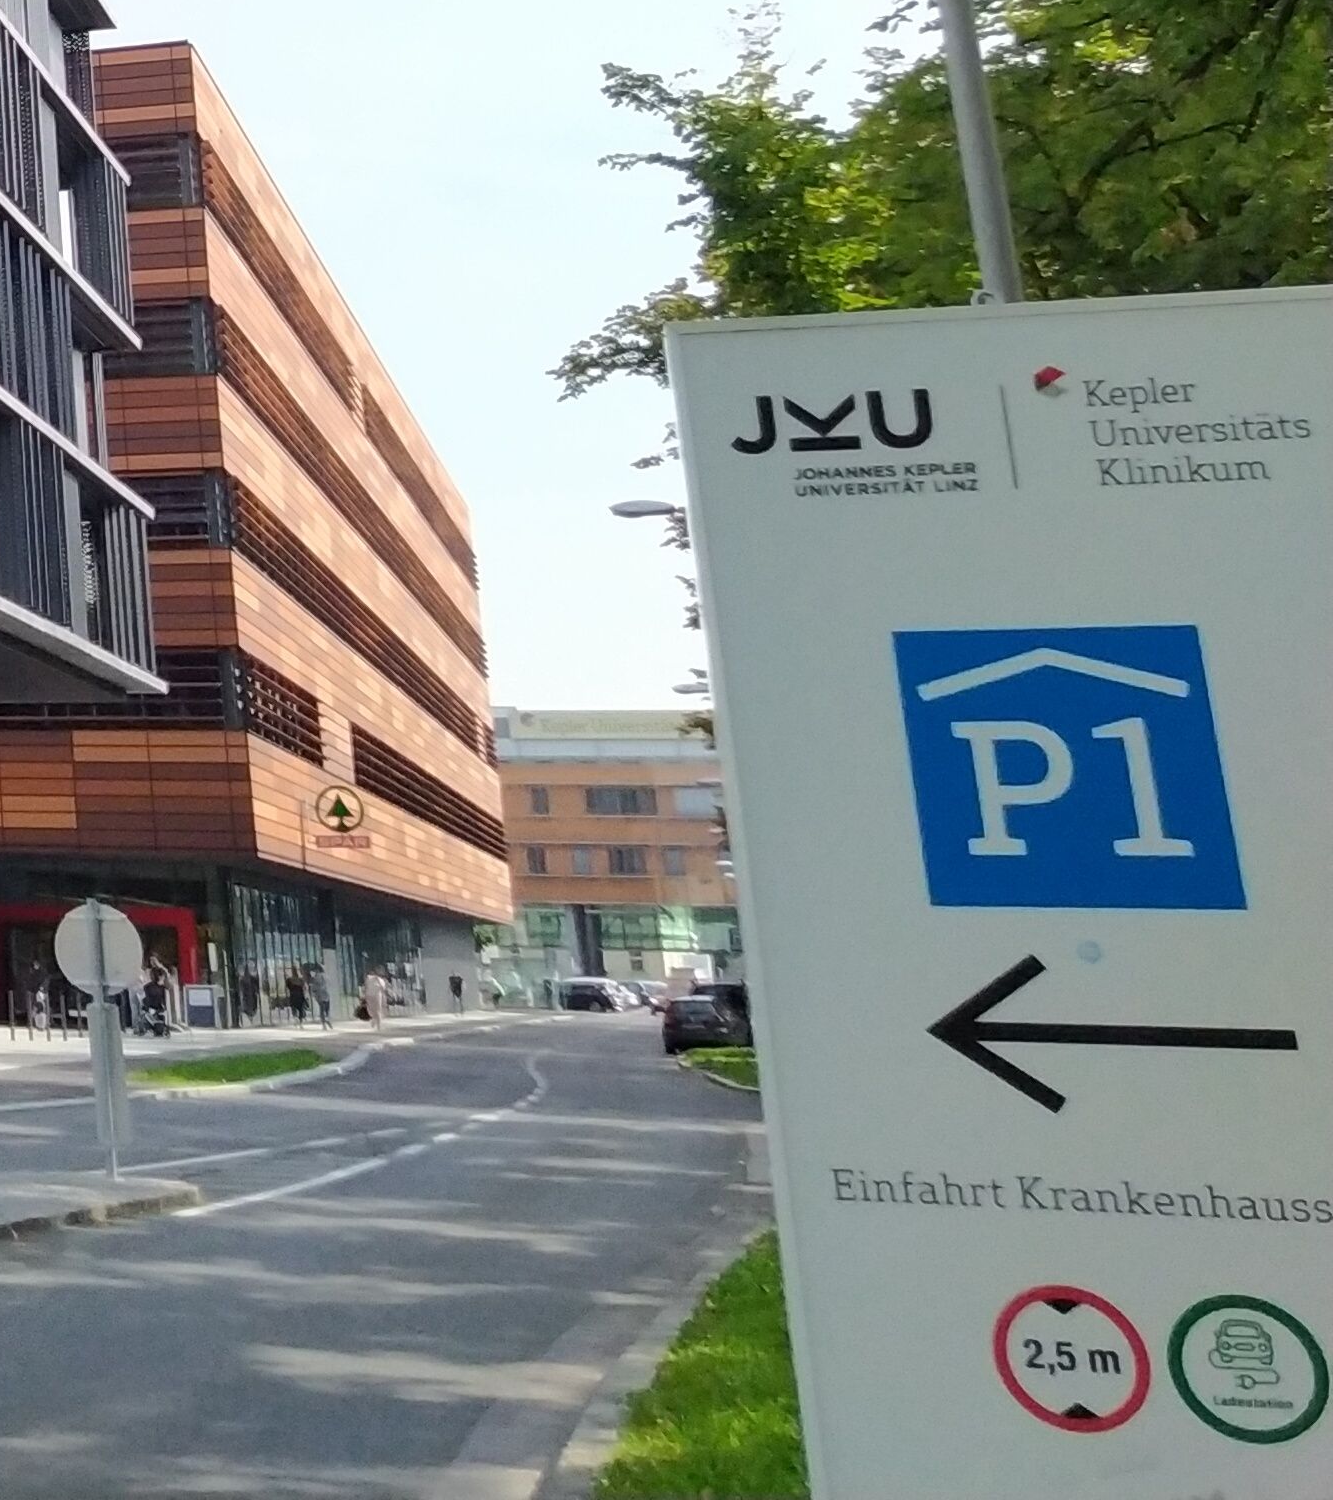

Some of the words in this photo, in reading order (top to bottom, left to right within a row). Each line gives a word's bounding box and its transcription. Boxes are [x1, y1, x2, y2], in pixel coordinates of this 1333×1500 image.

[1082, 377, 1196, 413] Kepler
[731, 388, 933, 454] JKU
[1088, 413, 1312, 447] Universitäts
[794, 464, 896, 480] JOHANNES
[904, 462, 976, 476] KEPLER
[795, 479, 925, 497] UNIVERSITÄT
[934, 479, 979, 492] LINZ
[1096, 455, 1272, 486] Klinikum
[950, 716, 1195, 857] P1
[831, 1168, 1005, 1209] Einfahrt
[1016, 1175, 1333, 1224] Krankenhauss
[1022, 1338, 1076, 1376] 2,5
[1089, 1347, 1121, 1375] m
